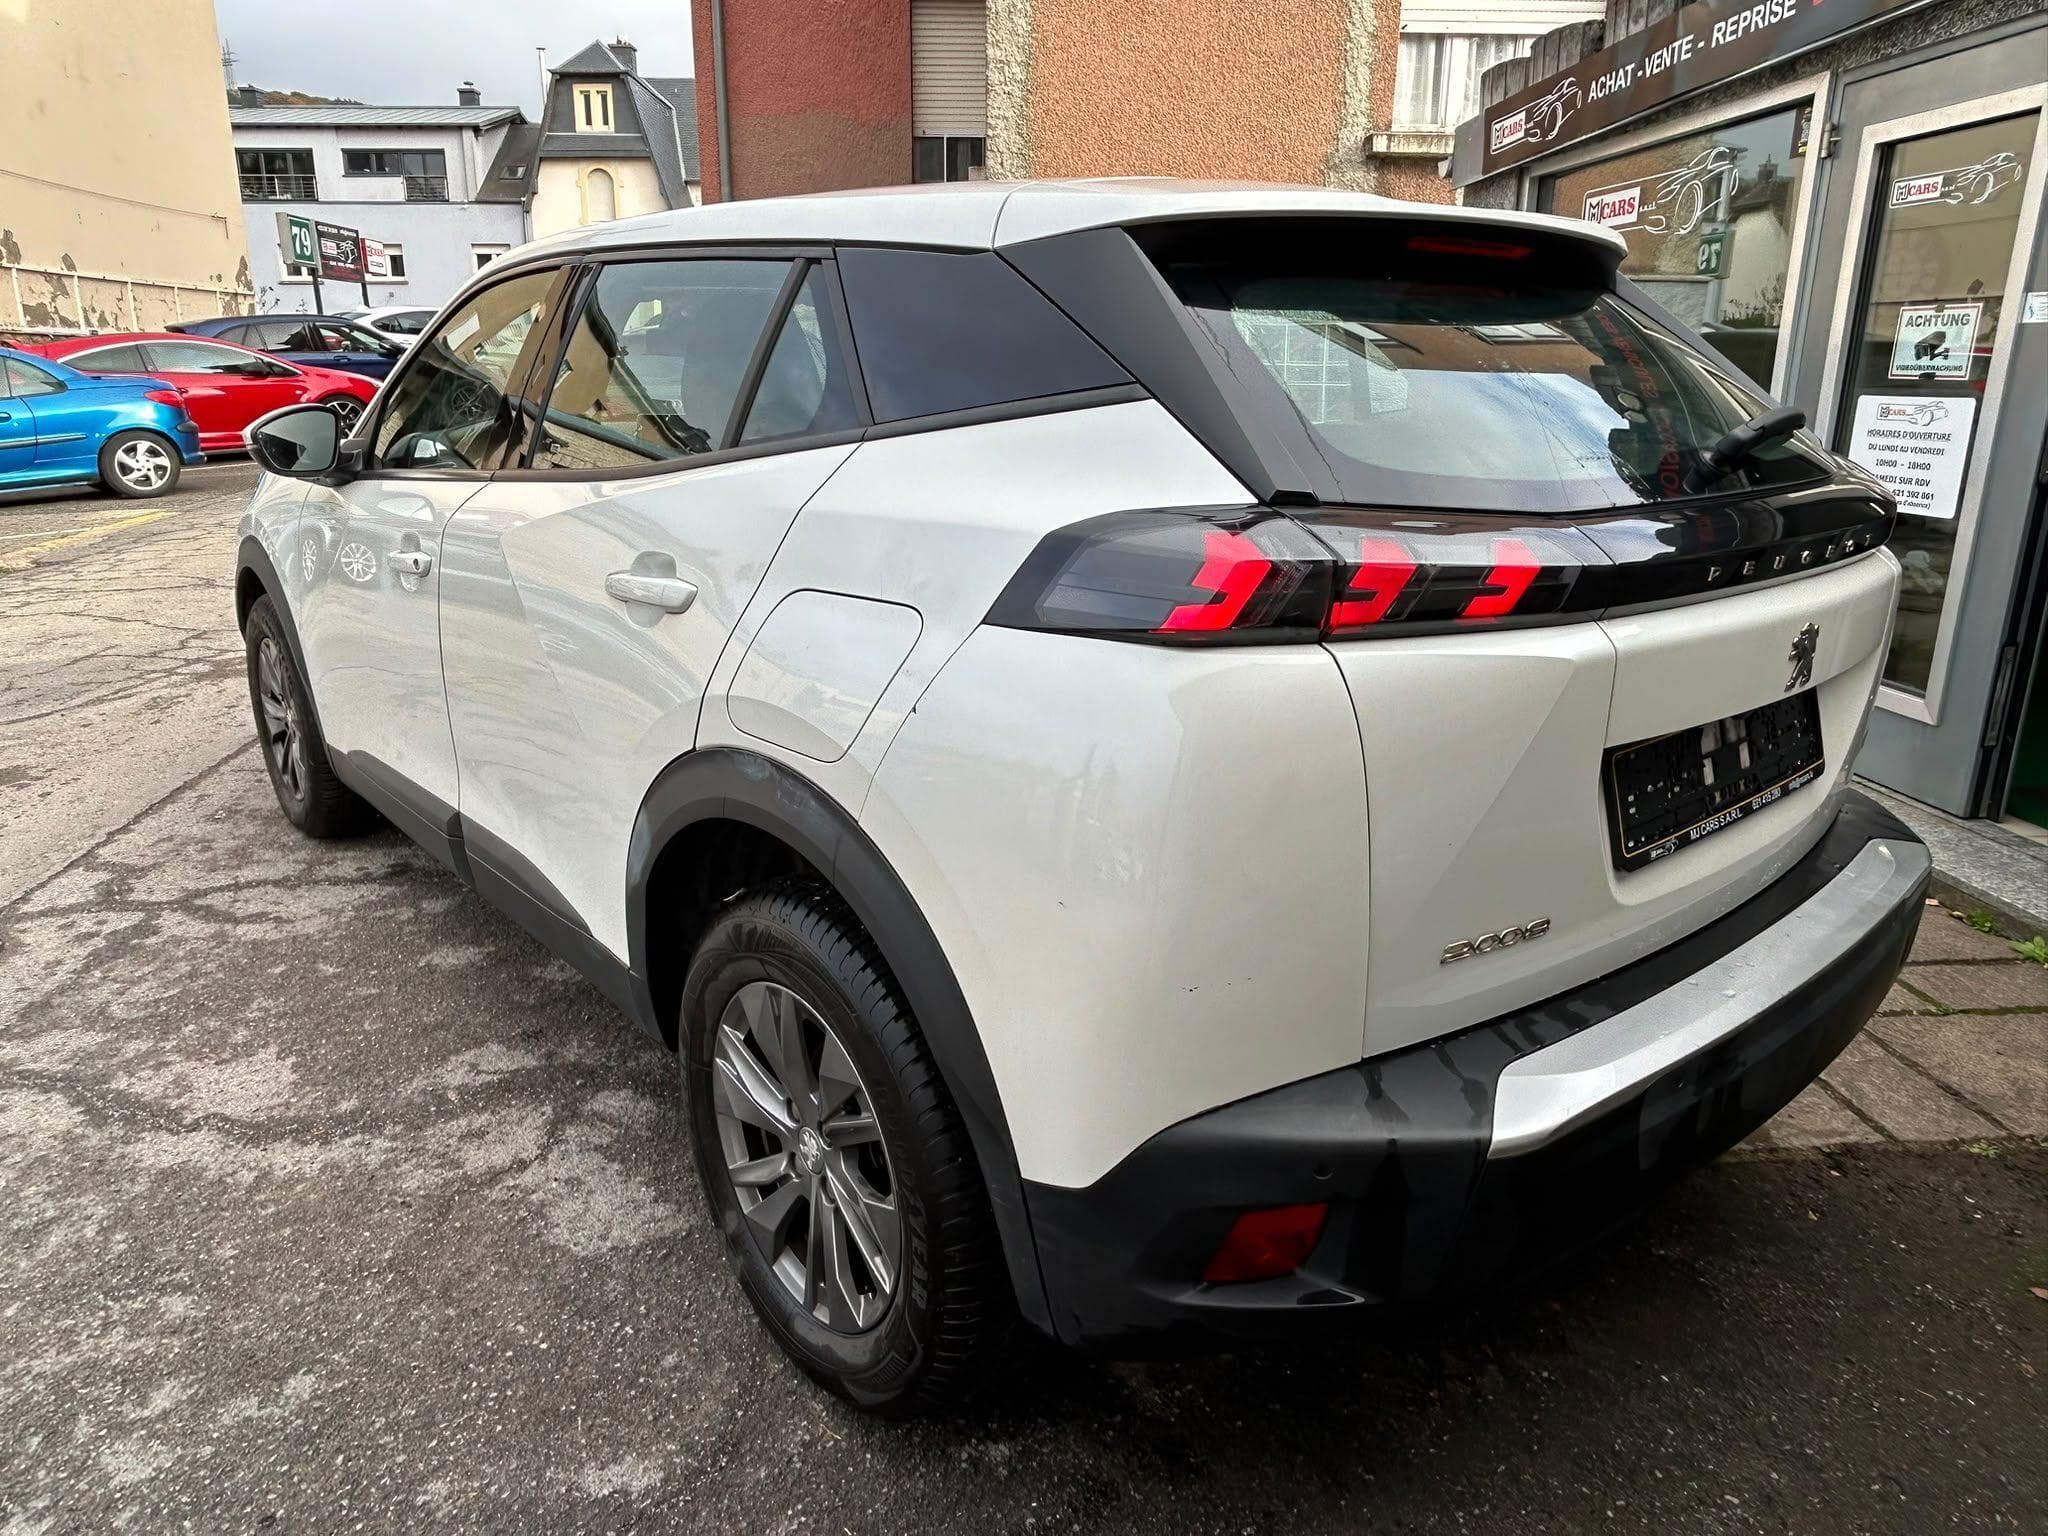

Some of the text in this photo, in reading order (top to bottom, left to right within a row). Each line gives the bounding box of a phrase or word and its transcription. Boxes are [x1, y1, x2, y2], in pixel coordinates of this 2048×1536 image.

[1588, 63, 1635, 102] ACHAT
[1645, 34, 1694, 78] VENTE
[1711, 0, 1798, 48] REPRISE
[1908, 181, 1939, 196] CARS
[1602, 197, 1637, 220] CARS
[292, 225, 312, 256] 79
[1905, 313, 1971, 328] ACHTUNG
[1867, 428, 1901, 438] HORAIRES
[1878, 444, 1899, 452] LUNDI
[1910, 446, 1945, 455] VENDREDI
[1876, 459, 1897, 468] 10H00
[1908, 461, 1931, 471] 18H00
[1873, 473, 1930, 487] AMEDI SUR RDV
[1701, 818, 1720, 835] CARS
[1440, 918, 1551, 964] 2008
